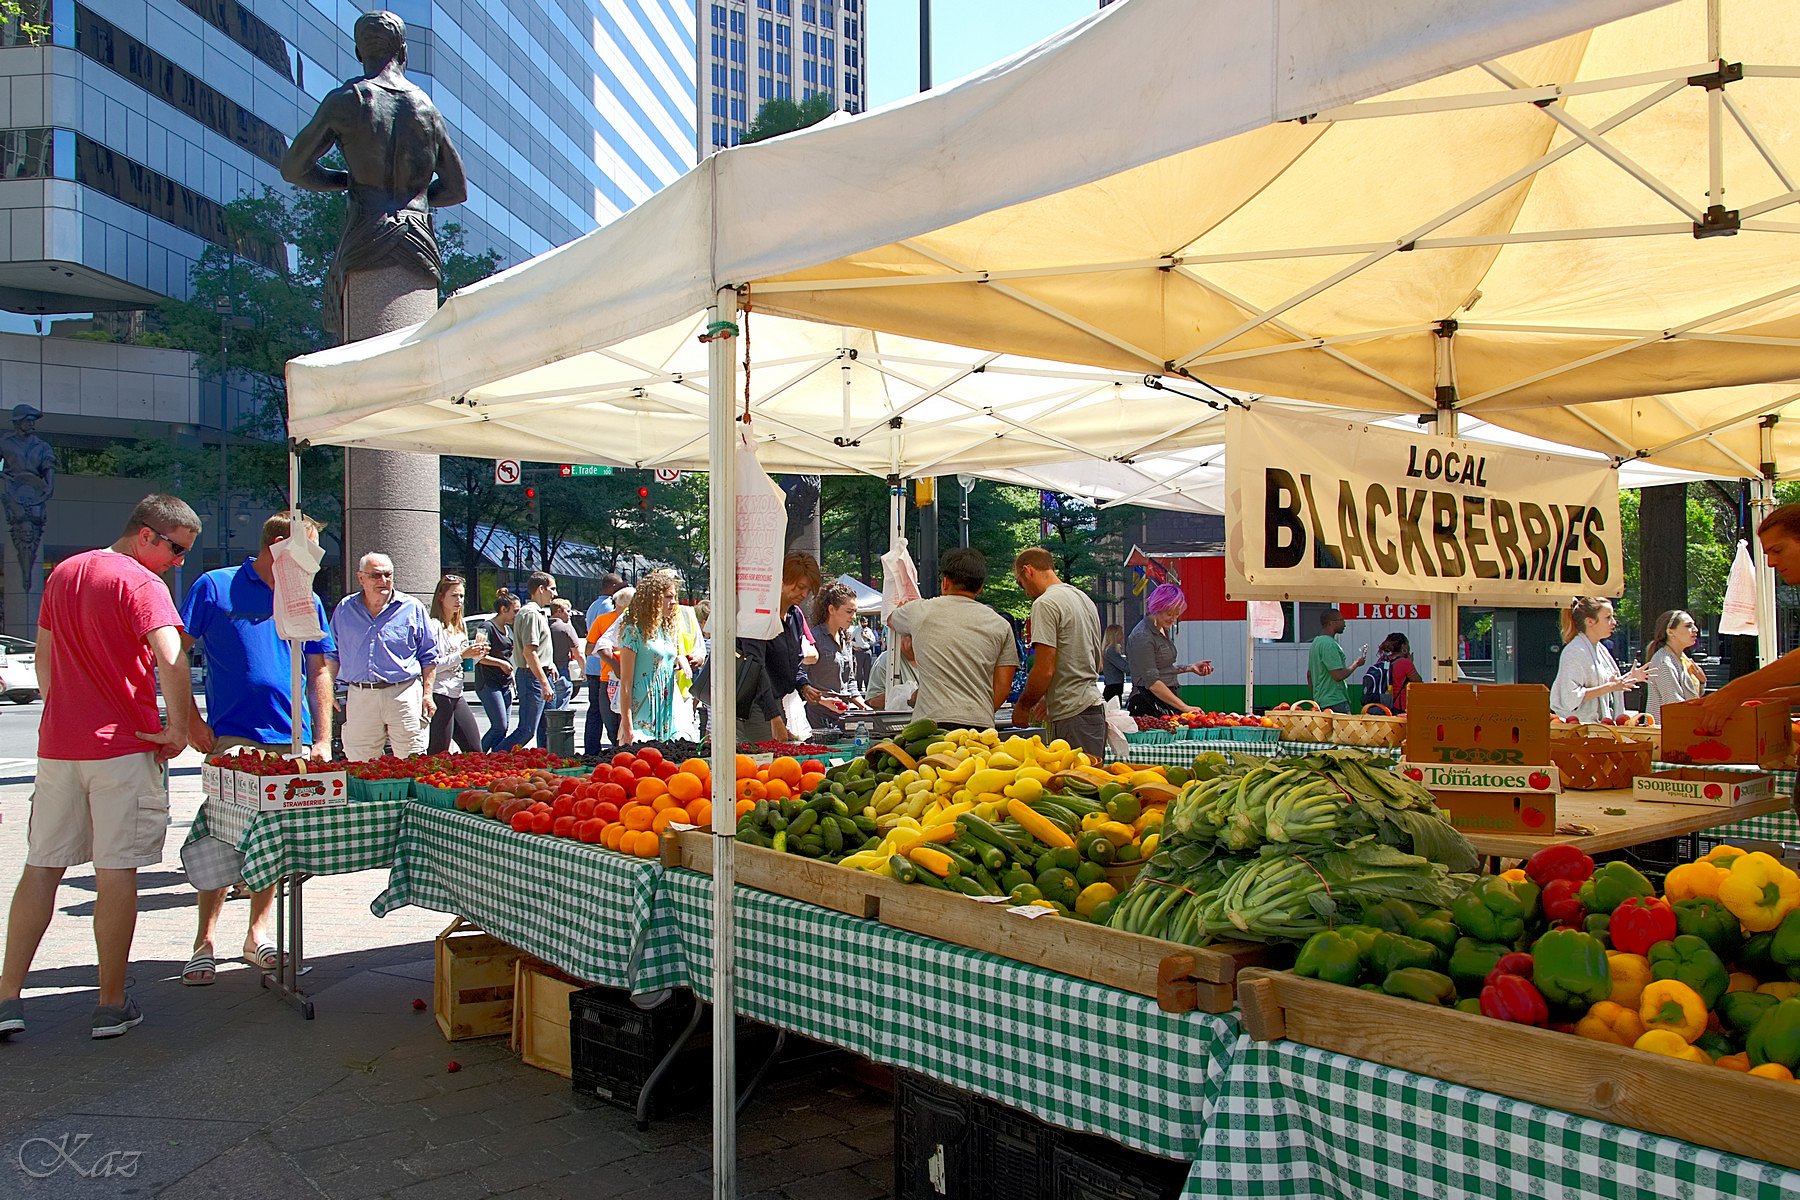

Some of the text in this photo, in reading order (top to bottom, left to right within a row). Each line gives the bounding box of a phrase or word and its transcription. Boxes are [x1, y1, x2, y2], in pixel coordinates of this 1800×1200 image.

[571, 465, 578, 474] E.
[579, 465, 598, 474] Trade
[1406, 445, 1488, 487] LOCAL
[736, 512, 777, 530] CIAS
[1264, 467, 1610, 586] BLACKBERRIES
[1356, 603, 1418, 619] TACOS
[1424, 767, 1526, 788] Tomatoes
[1449, 767, 1471, 775] fresh
[1637, 780, 1703, 799] Tomatoes
[283, 799, 326, 808] STRAWBERRIES
[1451, 815, 1514, 829] matoes
